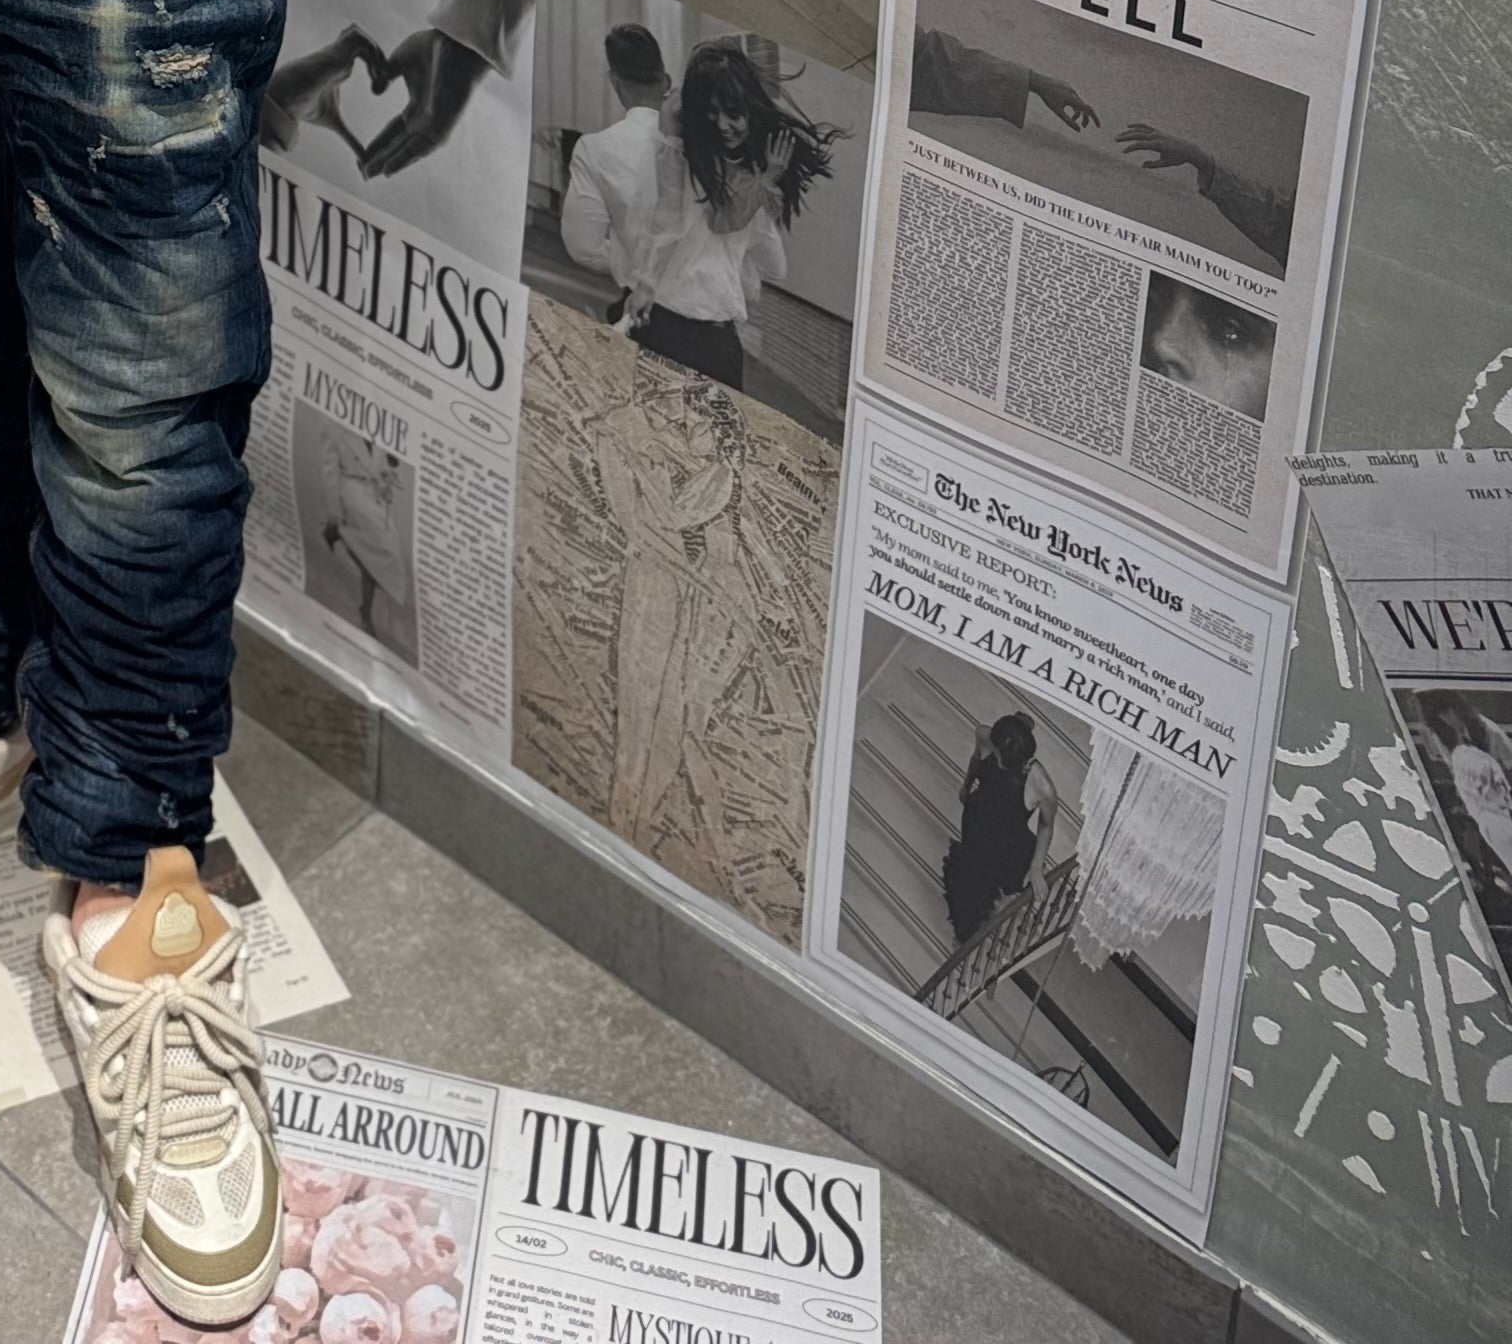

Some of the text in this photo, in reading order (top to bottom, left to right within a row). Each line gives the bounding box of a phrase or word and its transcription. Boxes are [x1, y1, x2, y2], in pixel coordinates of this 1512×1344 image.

[259, 164, 508, 392] IMELESS
[303, 362, 408, 455] MYSTIQUE
[1292, 450, 1419, 472] delights, making
[1299, 471, 1379, 487] destination.
[873, 500, 1058, 599] EXCLUSIVE REPORT:
[934, 472, 1185, 614] The New York News
[864, 570, 1237, 780] MOM, I AM A RICH MAN
[520, 1107, 866, 1282] TIMELESS
[514, 1232, 548, 1251] 14/02
[588, 1248, 781, 1305] CHIC, CLASSIC, EFFORTLESS
[825, 1307, 854, 1326] 2025
